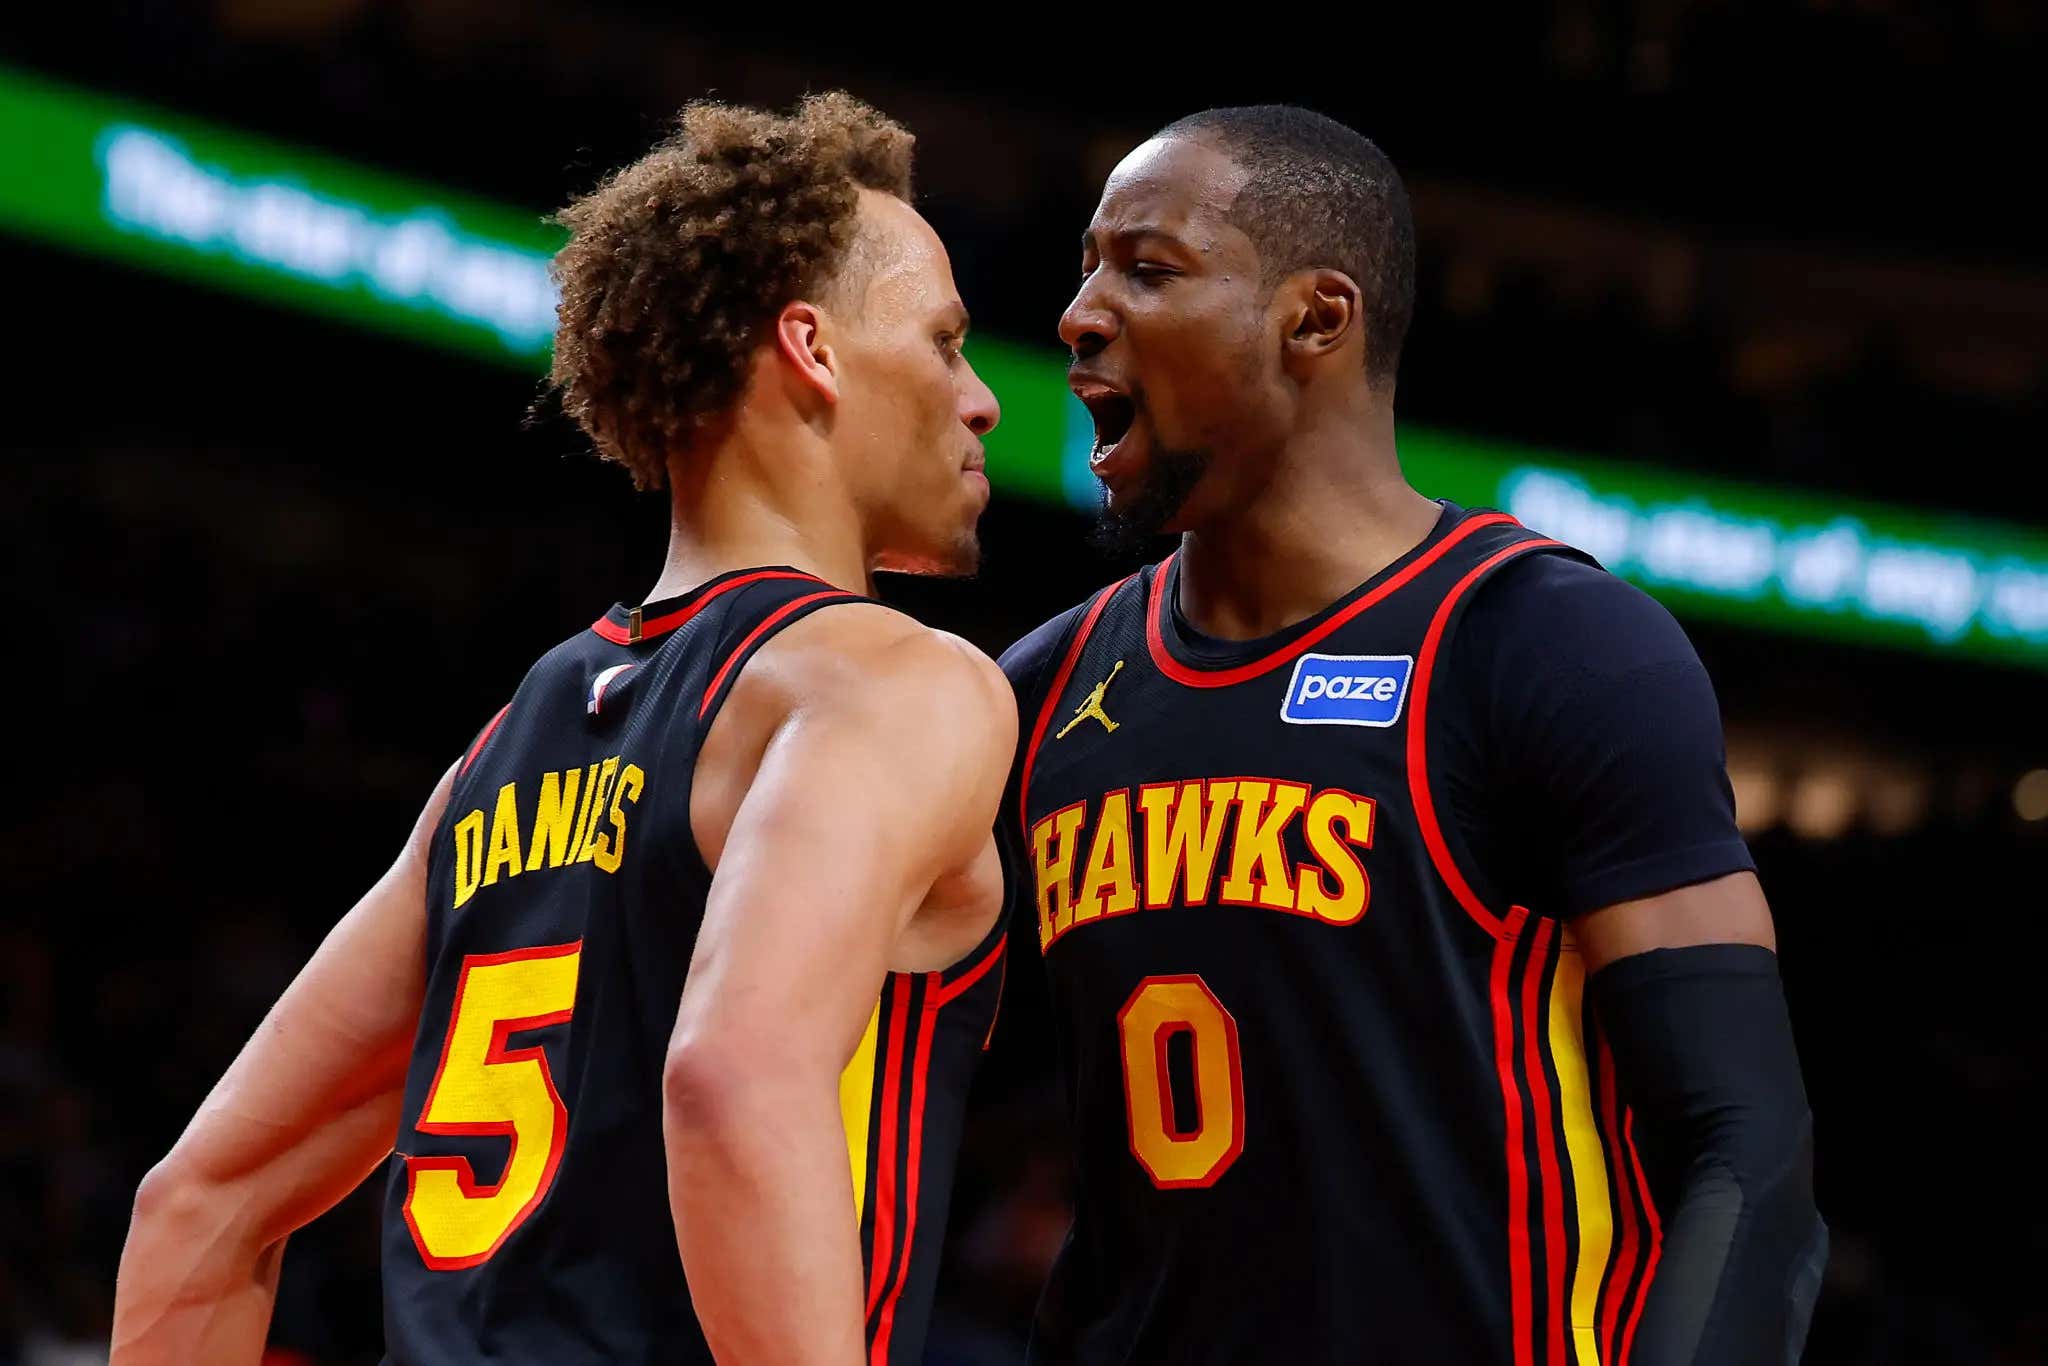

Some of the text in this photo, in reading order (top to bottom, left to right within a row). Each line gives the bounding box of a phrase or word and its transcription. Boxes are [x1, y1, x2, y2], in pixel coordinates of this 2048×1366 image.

[1297, 674, 1397, 705] paze
[1031, 776, 1376, 956] HAWKS
[402, 936, 582, 1271] 5
[1116, 973, 1245, 1190] 0
